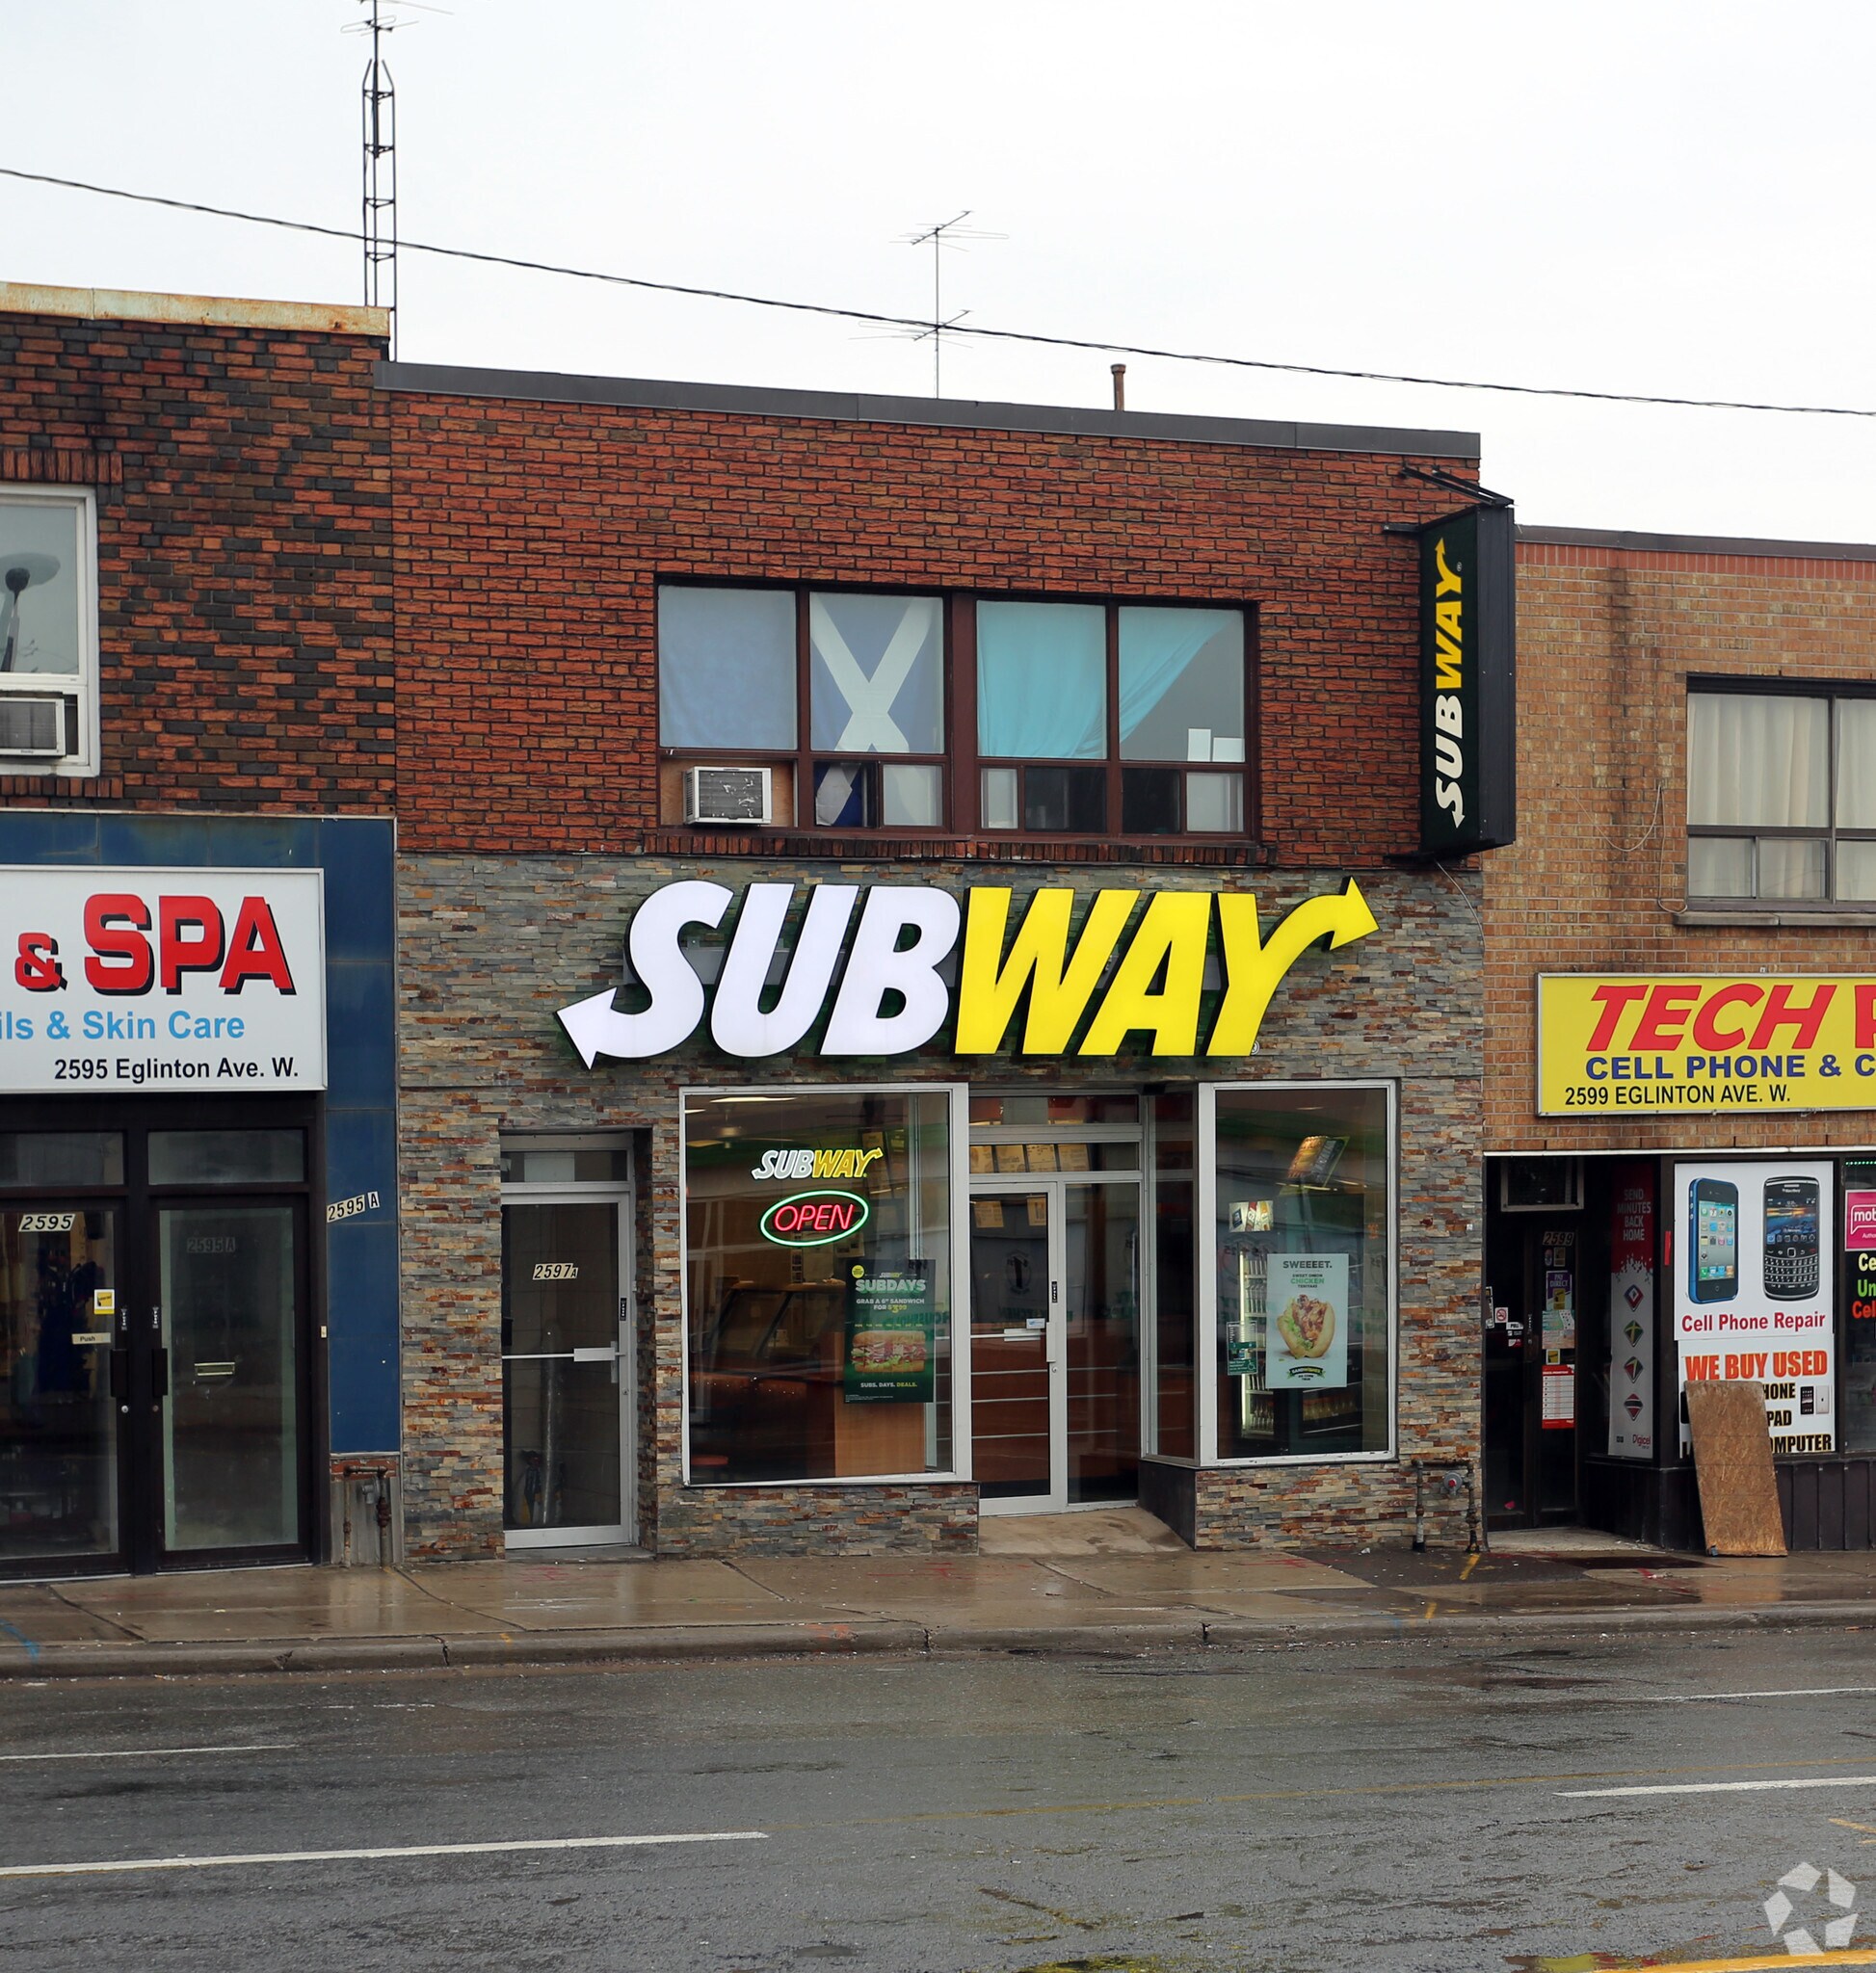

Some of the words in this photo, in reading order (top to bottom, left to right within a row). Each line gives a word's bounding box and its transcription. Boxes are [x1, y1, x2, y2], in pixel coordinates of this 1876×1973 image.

[1435, 538, 1466, 828] SUBWAY
[14, 932, 68, 992] &
[84, 893, 297, 995] SPA
[558, 877, 1379, 1069] SUBWAY
[46, 1011, 70, 1039] &
[83, 1011, 155, 1039] Skin
[169, 1010, 245, 1039] Care
[1586, 983, 1837, 1052] TECH
[55, 1059, 108, 1080] 2595
[117, 1058, 210, 1084] Eglinton
[217, 1058, 265, 1077] Ave.
[273, 1057, 299, 1077] W.
[1586, 1056, 1674, 1080] CELL
[1686, 1055, 1806, 1078] PHONE
[1818, 1055, 1842, 1077] &
[1565, 1087, 1608, 1105] 2599
[1616, 1085, 1714, 1105] EGLINTON
[1721, 1085, 1762, 1103] AVE.
[1769, 1085, 1790, 1102] W.
[752, 1147, 883, 1180] SUBWAY
[1624, 1189, 1644, 1200] SEND
[774, 1204, 855, 1231] OPEN
[1617, 1201, 1651, 1214] MINUTES
[20, 1216, 73, 1231] 2595
[1624, 1216, 1644, 1227] BACK
[1544, 1232, 1572, 1245] 2599
[1623, 1228, 1646, 1241] HOME
[1282, 1260, 1333, 1269] SWEEEET.
[856, 1279, 926, 1292] SUBDAYS
[1681, 1314, 1712, 1332] Cell
[1719, 1313, 1768, 1330] Phone
[1774, 1311, 1826, 1331] Repair
[1685, 1355, 1720, 1381] WE
[1725, 1353, 1768, 1380] BUY
[1773, 1351, 1828, 1378] USED
